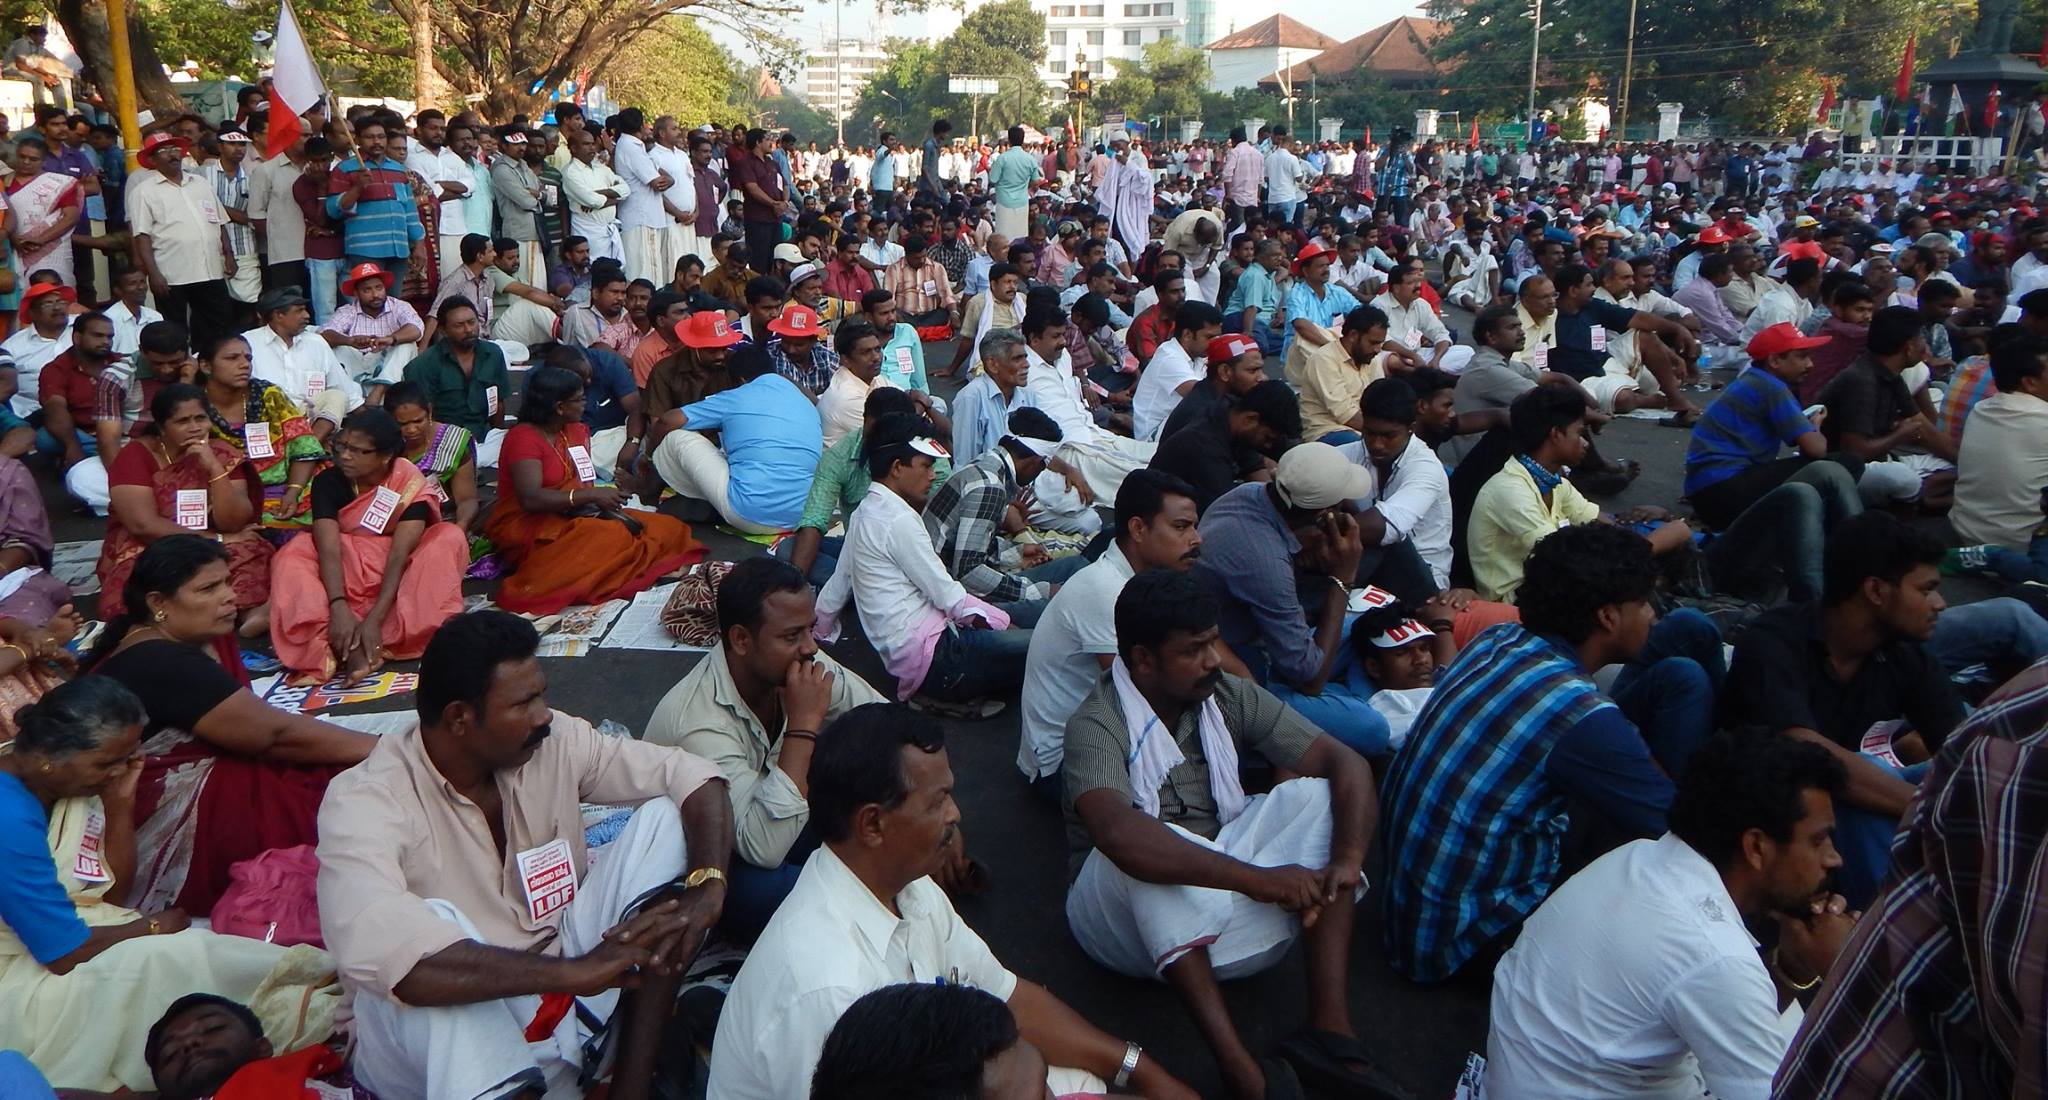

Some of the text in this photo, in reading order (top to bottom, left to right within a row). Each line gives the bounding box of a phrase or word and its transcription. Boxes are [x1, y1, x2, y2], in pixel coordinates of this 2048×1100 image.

[181, 516, 204, 526] LDF
[365, 512, 385, 529] LDF
[75, 855, 101, 876] LDF
[535, 884, 573, 918] LDF
